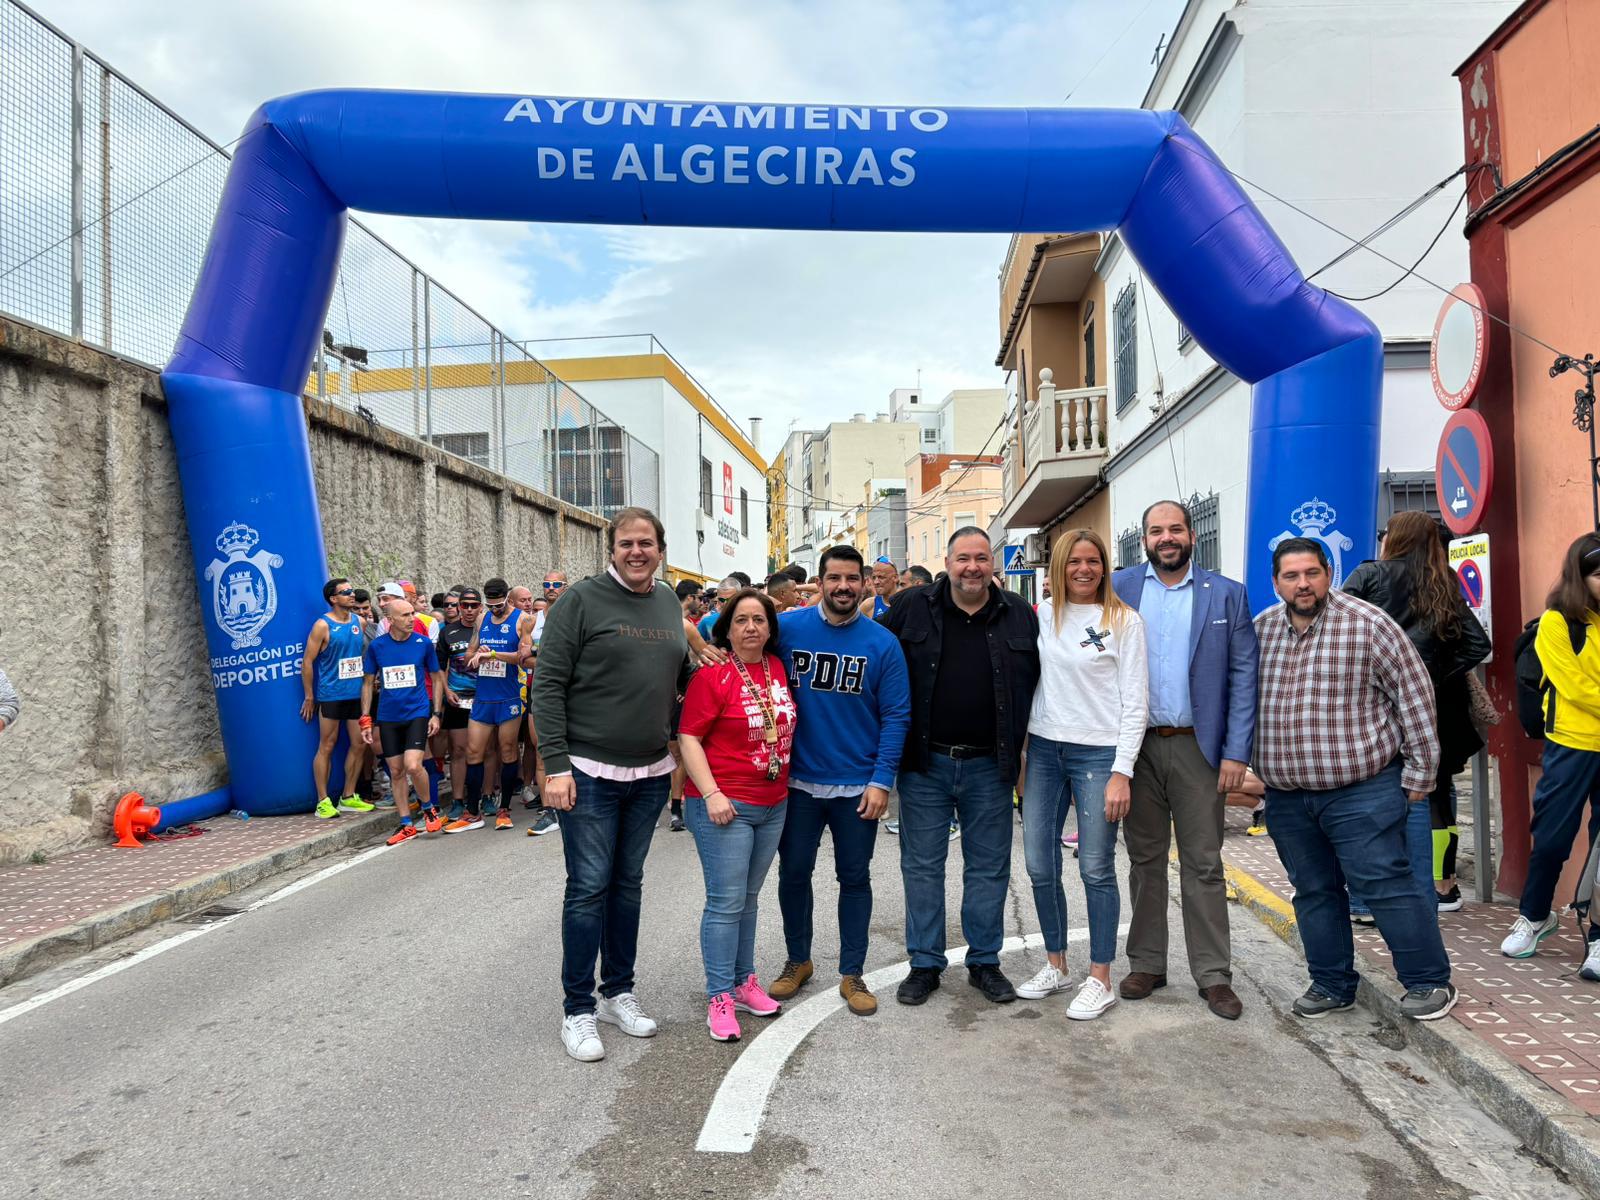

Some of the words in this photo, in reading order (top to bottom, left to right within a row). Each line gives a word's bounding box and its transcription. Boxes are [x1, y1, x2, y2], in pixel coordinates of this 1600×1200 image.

[503, 98, 949, 132] AYUNTAMIENTO
[537, 147, 595, 180] DE
[611, 142, 917, 187] ALGECIRAS
[1462, 384, 1472, 397] DE
[1470, 543, 1487, 556] LOCAL
[619, 624, 677, 640] HACKETT
[210, 647, 282, 669] DELEGACIÓN
[285, 643, 304, 656] DE
[213, 657, 303, 688] DEPORTES
[348, 663, 357, 672] 30
[394, 671, 406, 681] 13
[790, 650, 867, 695] PDH
[761, 709, 773, 730] SIXTIES
